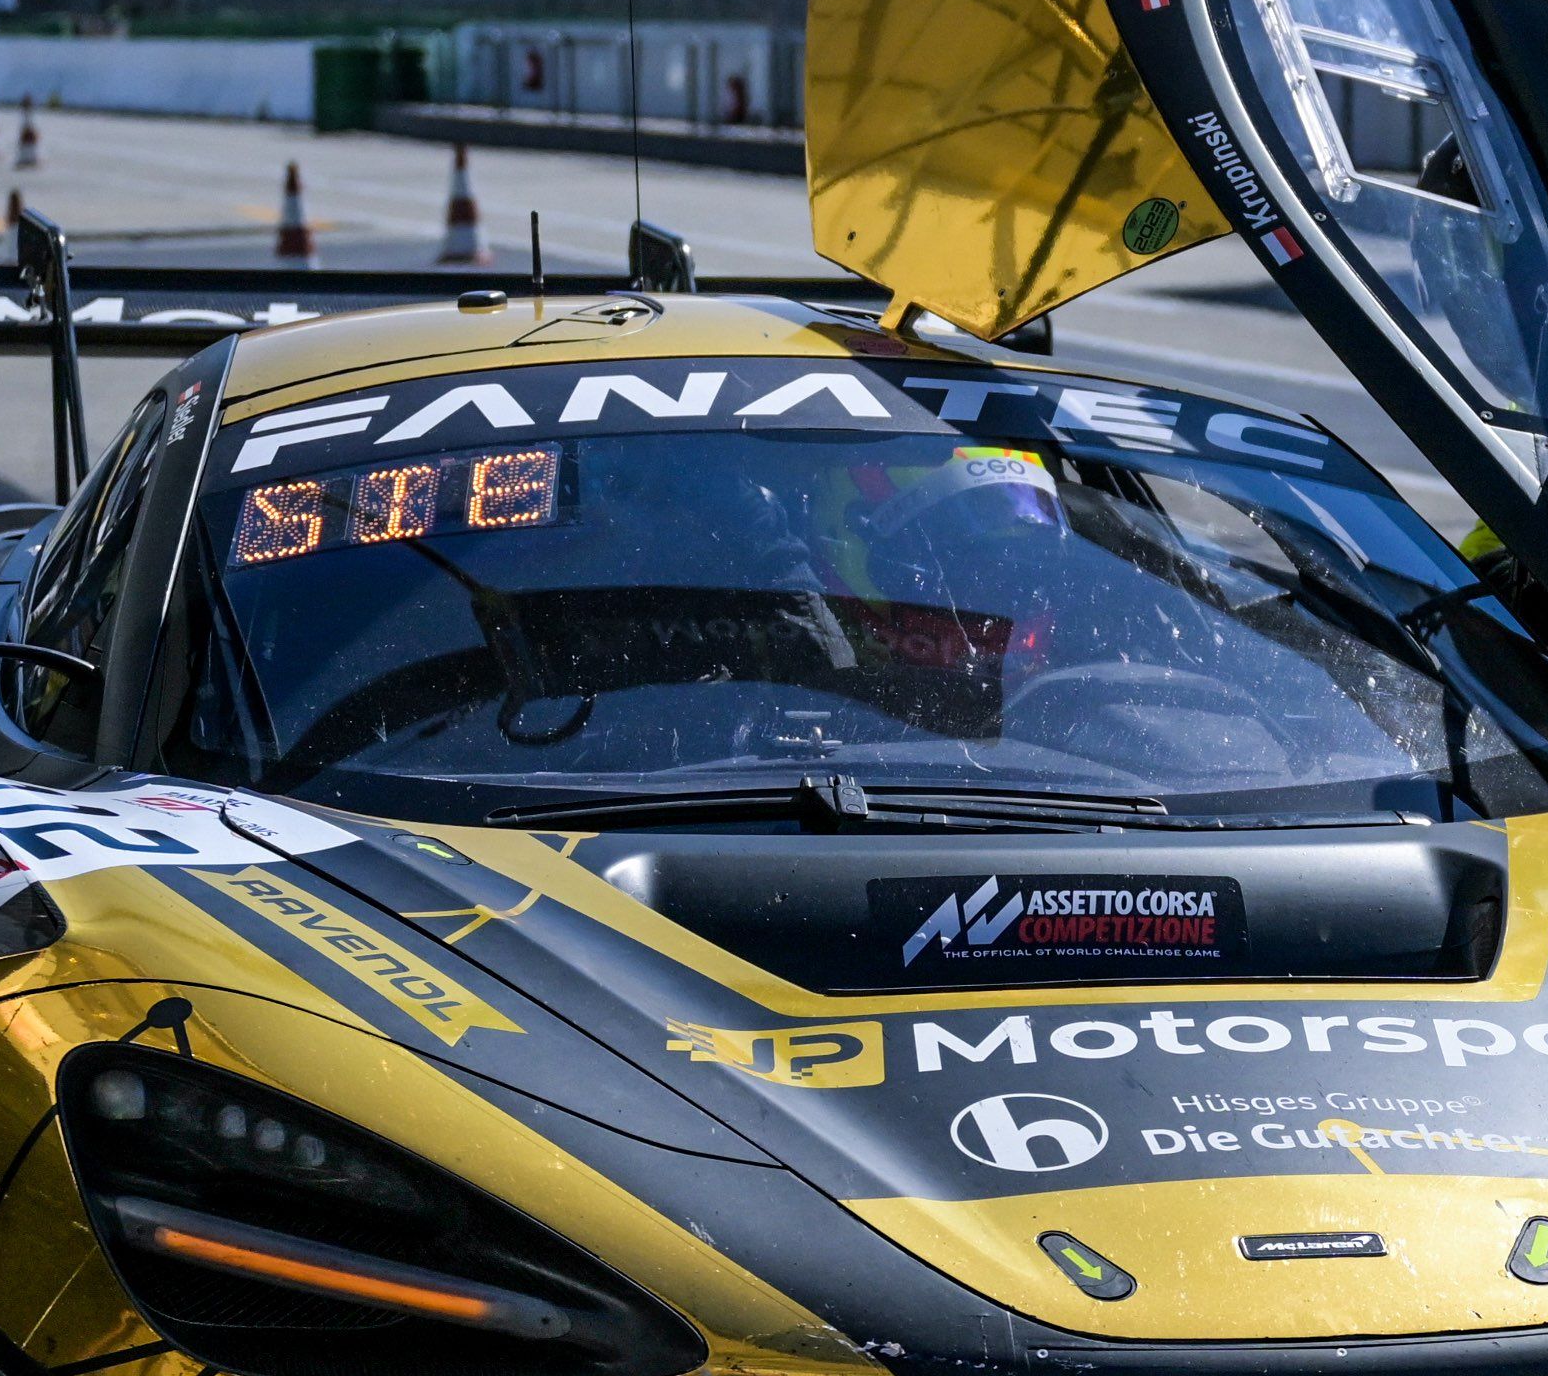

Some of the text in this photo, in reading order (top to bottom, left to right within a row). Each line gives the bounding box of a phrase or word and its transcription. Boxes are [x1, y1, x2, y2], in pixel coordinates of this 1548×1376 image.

[1188, 111, 1277, 229] Krupinski
[1133, 201, 1166, 251] 2023
[230, 372, 1329, 473] FANATEC
[1027, 890, 1215, 916] ASSETTO CORSA
[1018, 917, 1216, 944] COMPETIZIONE
[229, 878, 461, 1022] RAVENOL
[943, 949, 1221, 959] THE OFFICIAL GT WORLD CHALLENGE GAME
[727, 1029, 860, 1081] JP
[1172, 1094, 1315, 1115] Hüsges
[1141, 1123, 1530, 1156] Die Gutachter
[1256, 1235, 1364, 1252] McLaren
